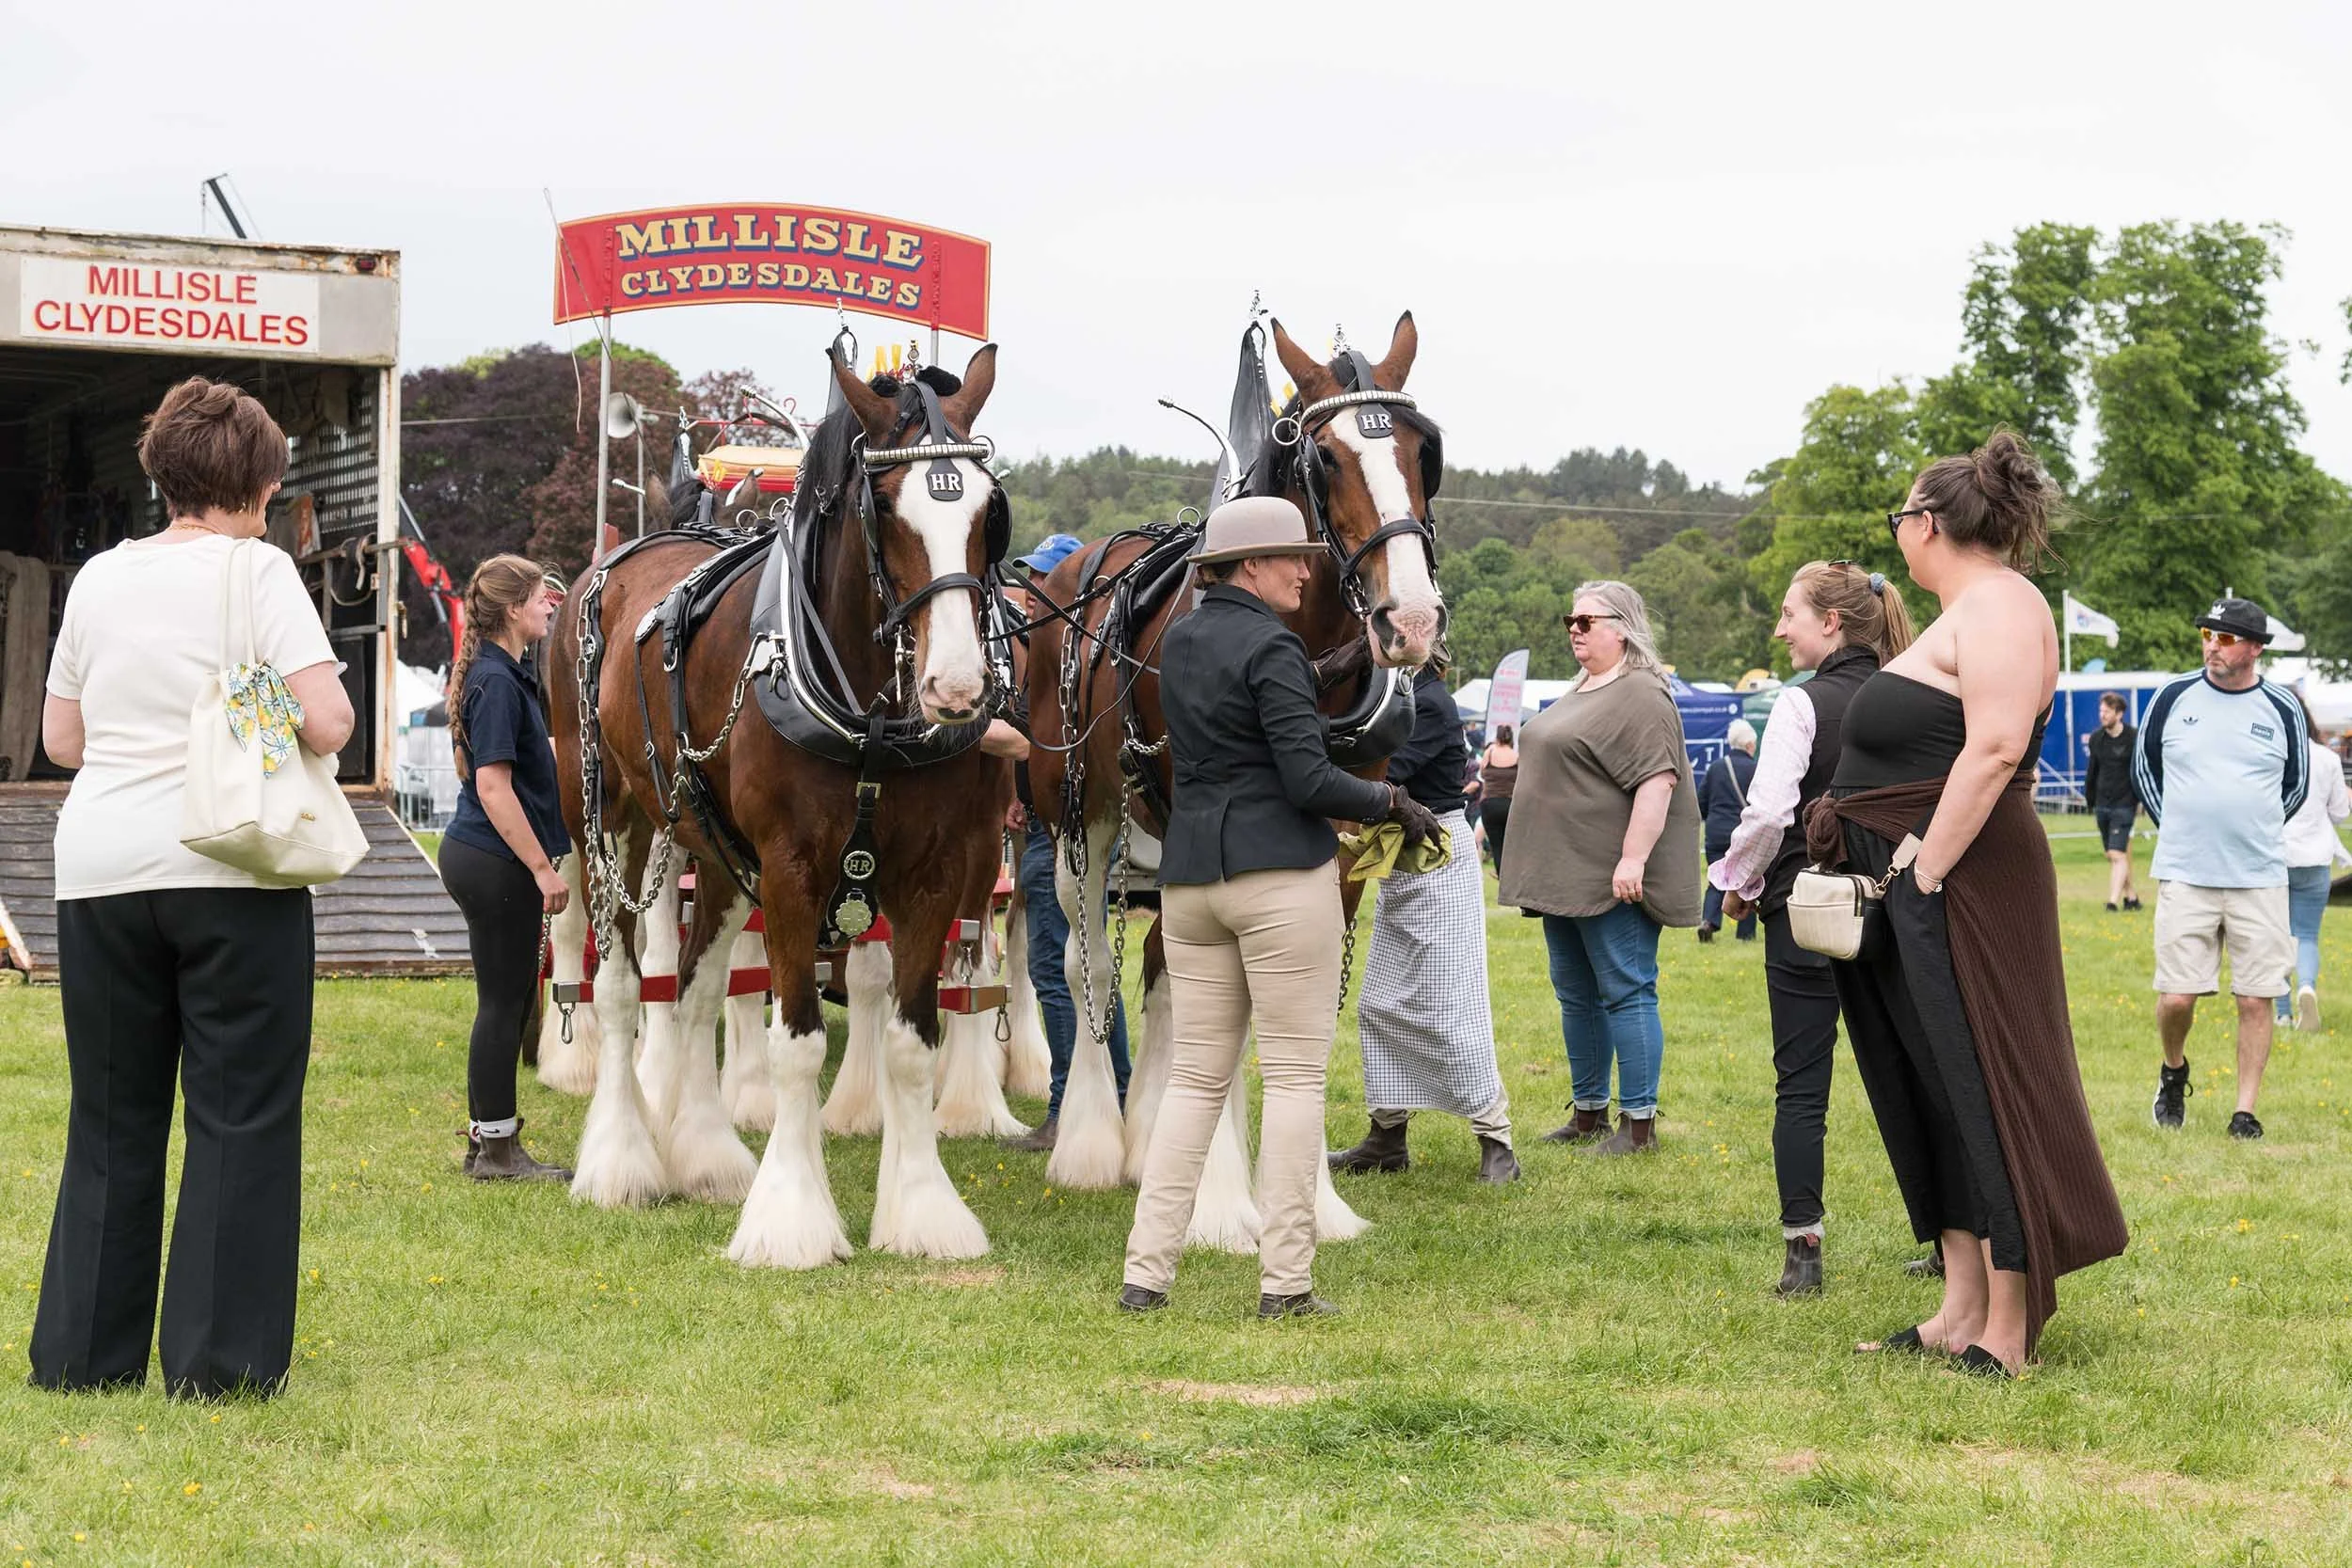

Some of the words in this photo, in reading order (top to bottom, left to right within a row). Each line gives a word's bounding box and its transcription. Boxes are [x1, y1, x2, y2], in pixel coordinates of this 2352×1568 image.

[615, 214, 924, 267] MILLISLE
[87, 265, 257, 305] MILLISLE
[621, 263, 921, 309] CLYDESDALES
[34, 300, 309, 345] CLYDESDALES
[1361, 414, 1392, 430] HR
[930, 473, 962, 491] HR
[850, 859, 870, 872] HR
